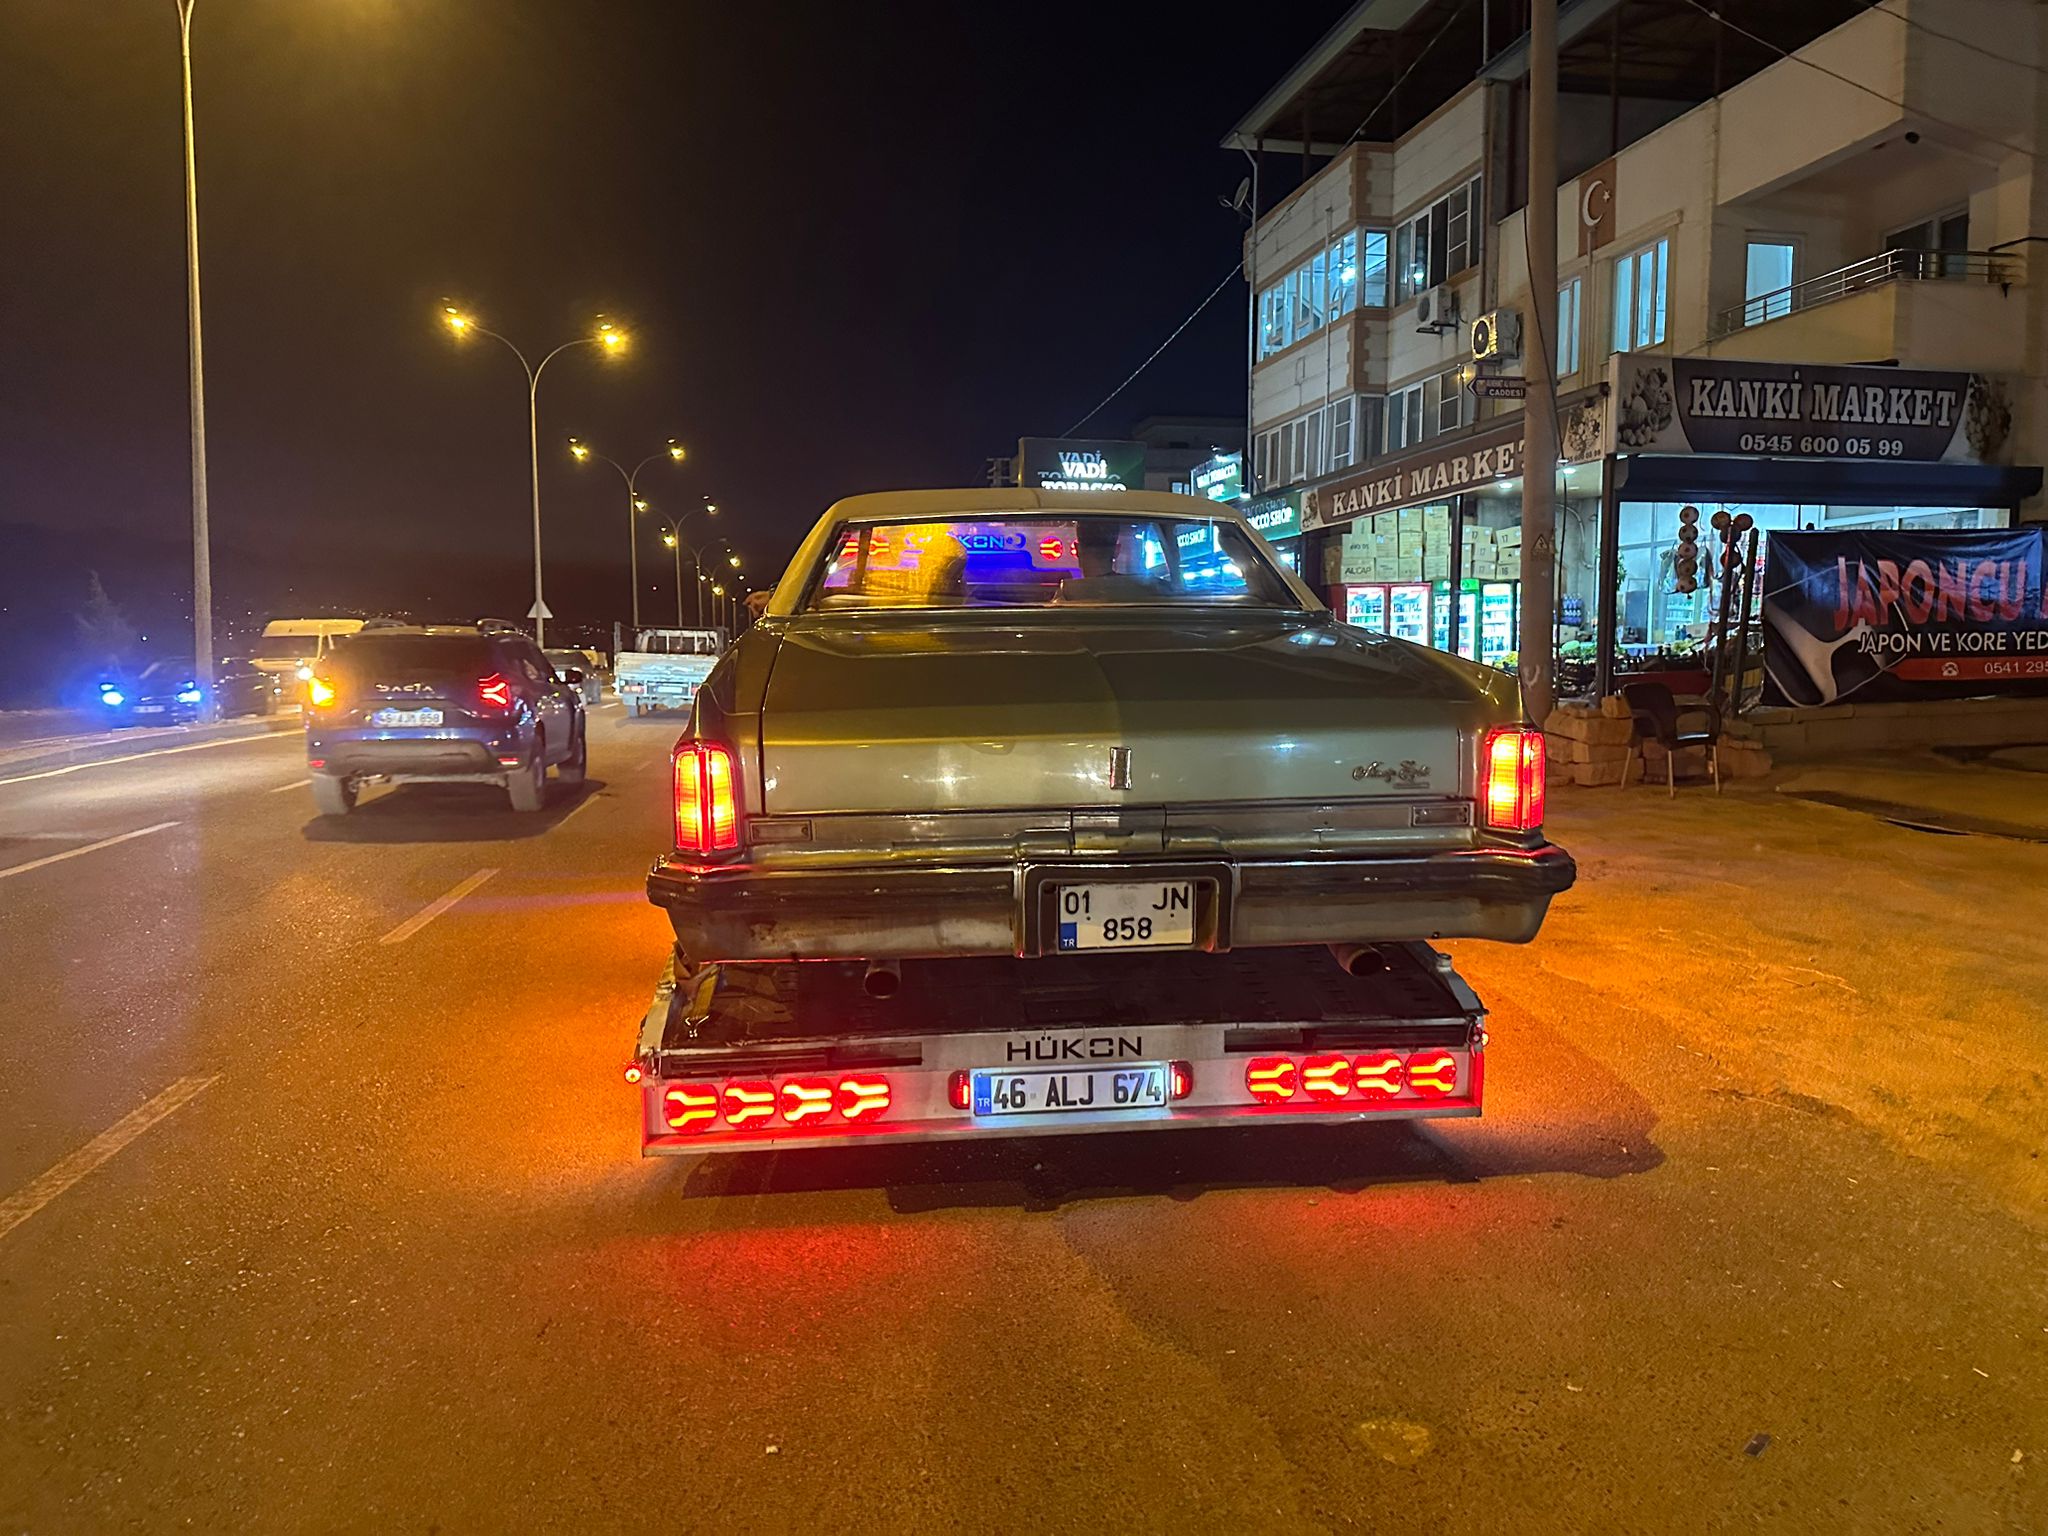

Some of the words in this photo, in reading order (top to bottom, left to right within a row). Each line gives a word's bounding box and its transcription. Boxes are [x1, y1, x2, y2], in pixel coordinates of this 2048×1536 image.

[1689, 370, 1802, 419] KANKİ
[1811, 384, 1956, 427] MARKET
[1739, 433, 1793, 452] 0545
[1800, 436, 1840, 454] 600
[1845, 438, 1872, 455] 05
[1878, 439, 1904, 456] 99
[1061, 459, 1107, 479] VADİ
[1331, 467, 1403, 517] KANKİ
[1270, 507, 1293, 527] SHOP
[957, 534, 1005, 549] KON
[1833, 555, 2028, 631] JAPONCU
[1857, 633, 1921, 654] JAPON
[1927, 632, 1951, 652] VE
[1955, 632, 2007, 651] KORE
[1984, 662, 2020, 674] 0541
[1064, 890, 1091, 915] 01
[1152, 886, 1189, 910] JN
[1103, 917, 1152, 941] 858
[1063, 938, 1075, 948] TR
[1006, 1035, 1142, 1062] HÜKON
[977, 1097, 990, 1108] TR
[993, 1078, 1026, 1109] 46
[1045, 1075, 1094, 1107] ALJ
[1112, 1071, 1162, 1103] 674
